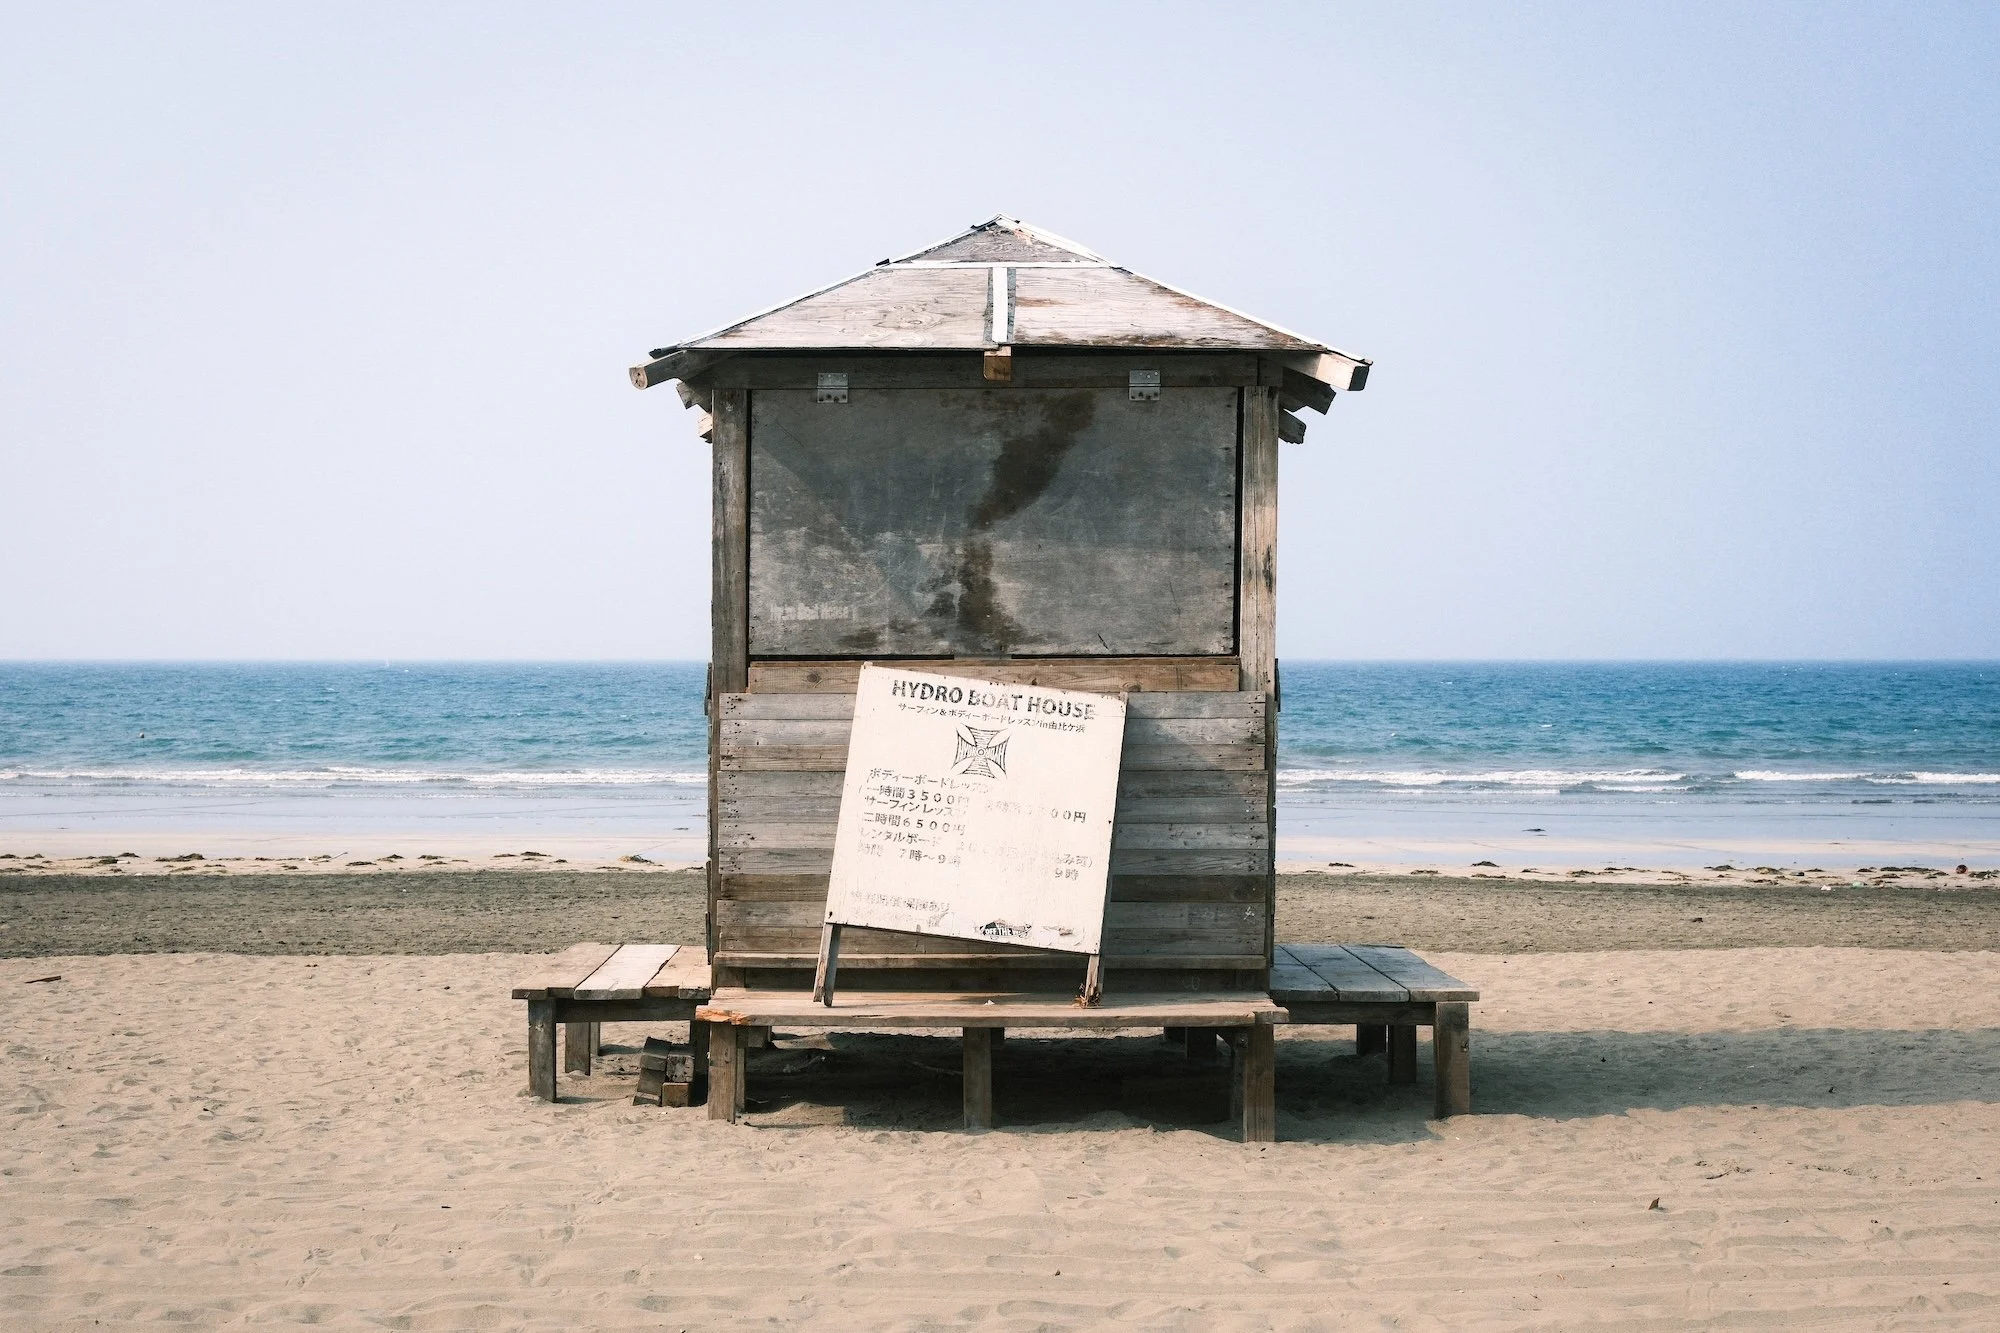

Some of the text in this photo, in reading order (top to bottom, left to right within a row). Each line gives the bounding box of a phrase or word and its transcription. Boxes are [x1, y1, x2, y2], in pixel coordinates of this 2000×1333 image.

[892, 679, 1095, 720] HYDRO BOAT HOUSE
[864, 795, 967, 817] サーフィンレッス
